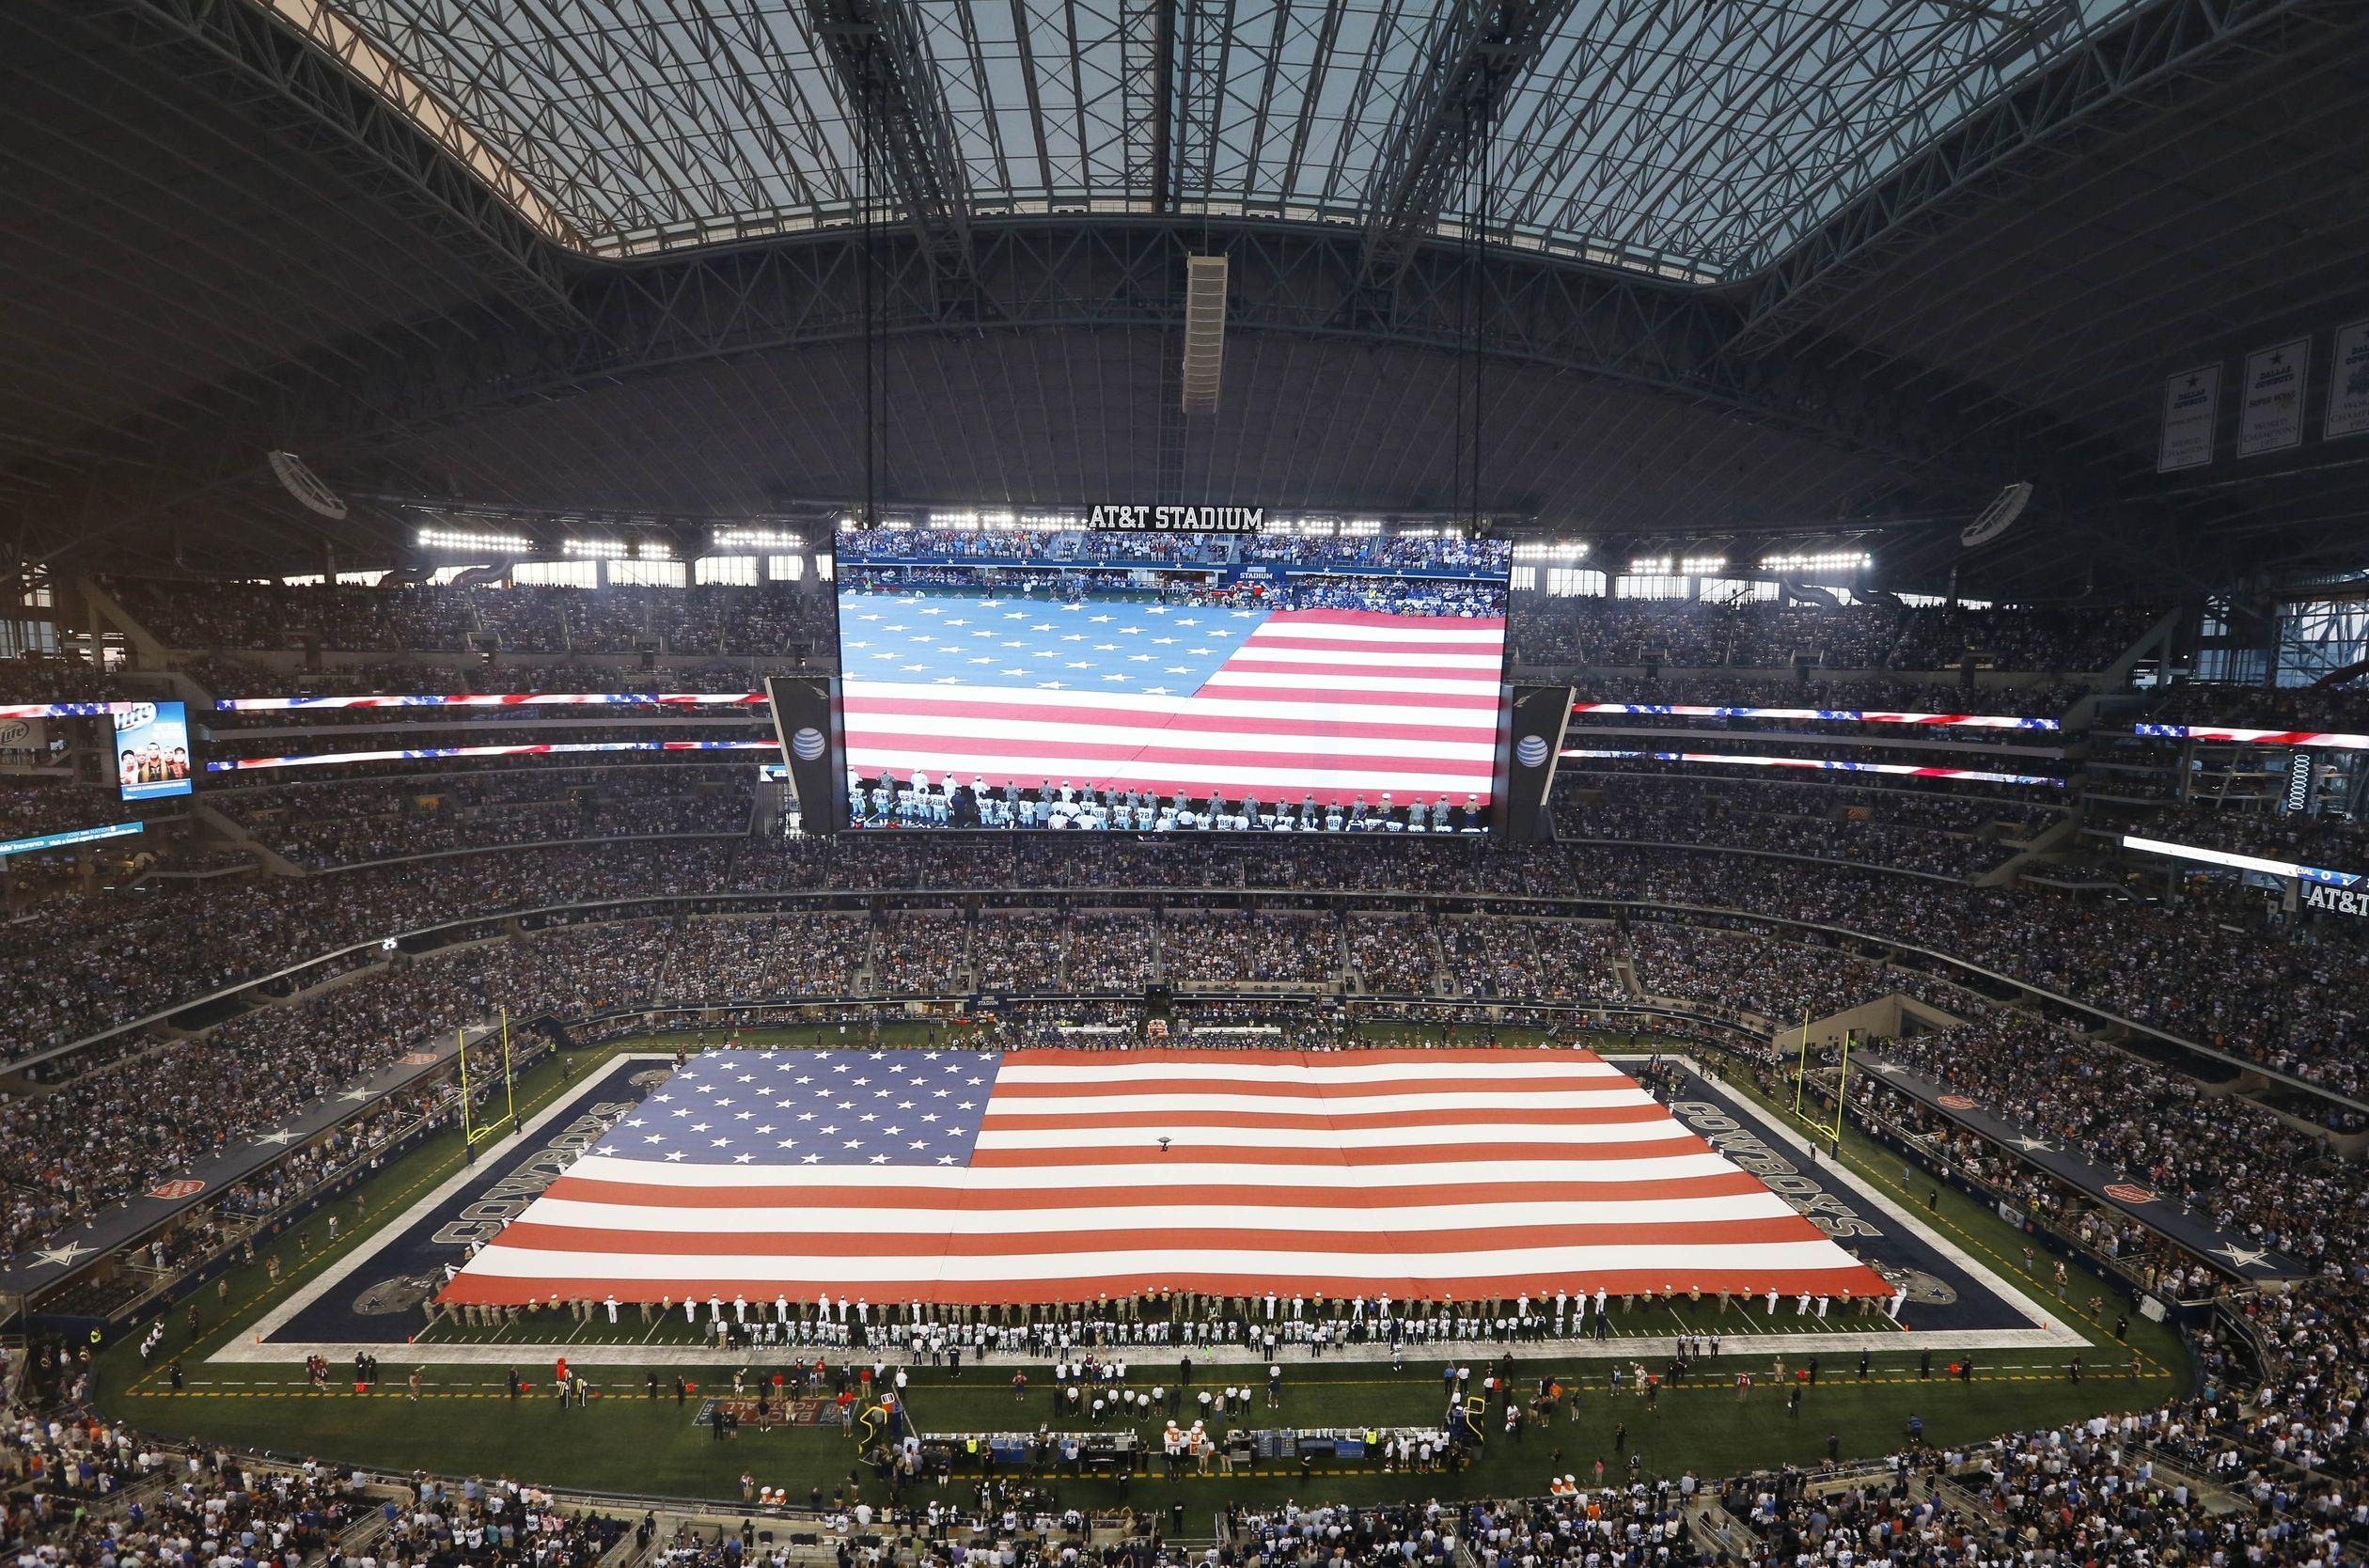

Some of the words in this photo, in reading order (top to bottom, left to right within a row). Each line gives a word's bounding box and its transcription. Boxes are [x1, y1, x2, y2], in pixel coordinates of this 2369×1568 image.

[1089, 506, 1150, 529] AT&T
[1155, 506, 1263, 530] STADIUM
[2297, 868, 2315, 877] DAL
[2307, 886, 2369, 916] AT&T
[1673, 1102, 1884, 1237] COWBOYS
